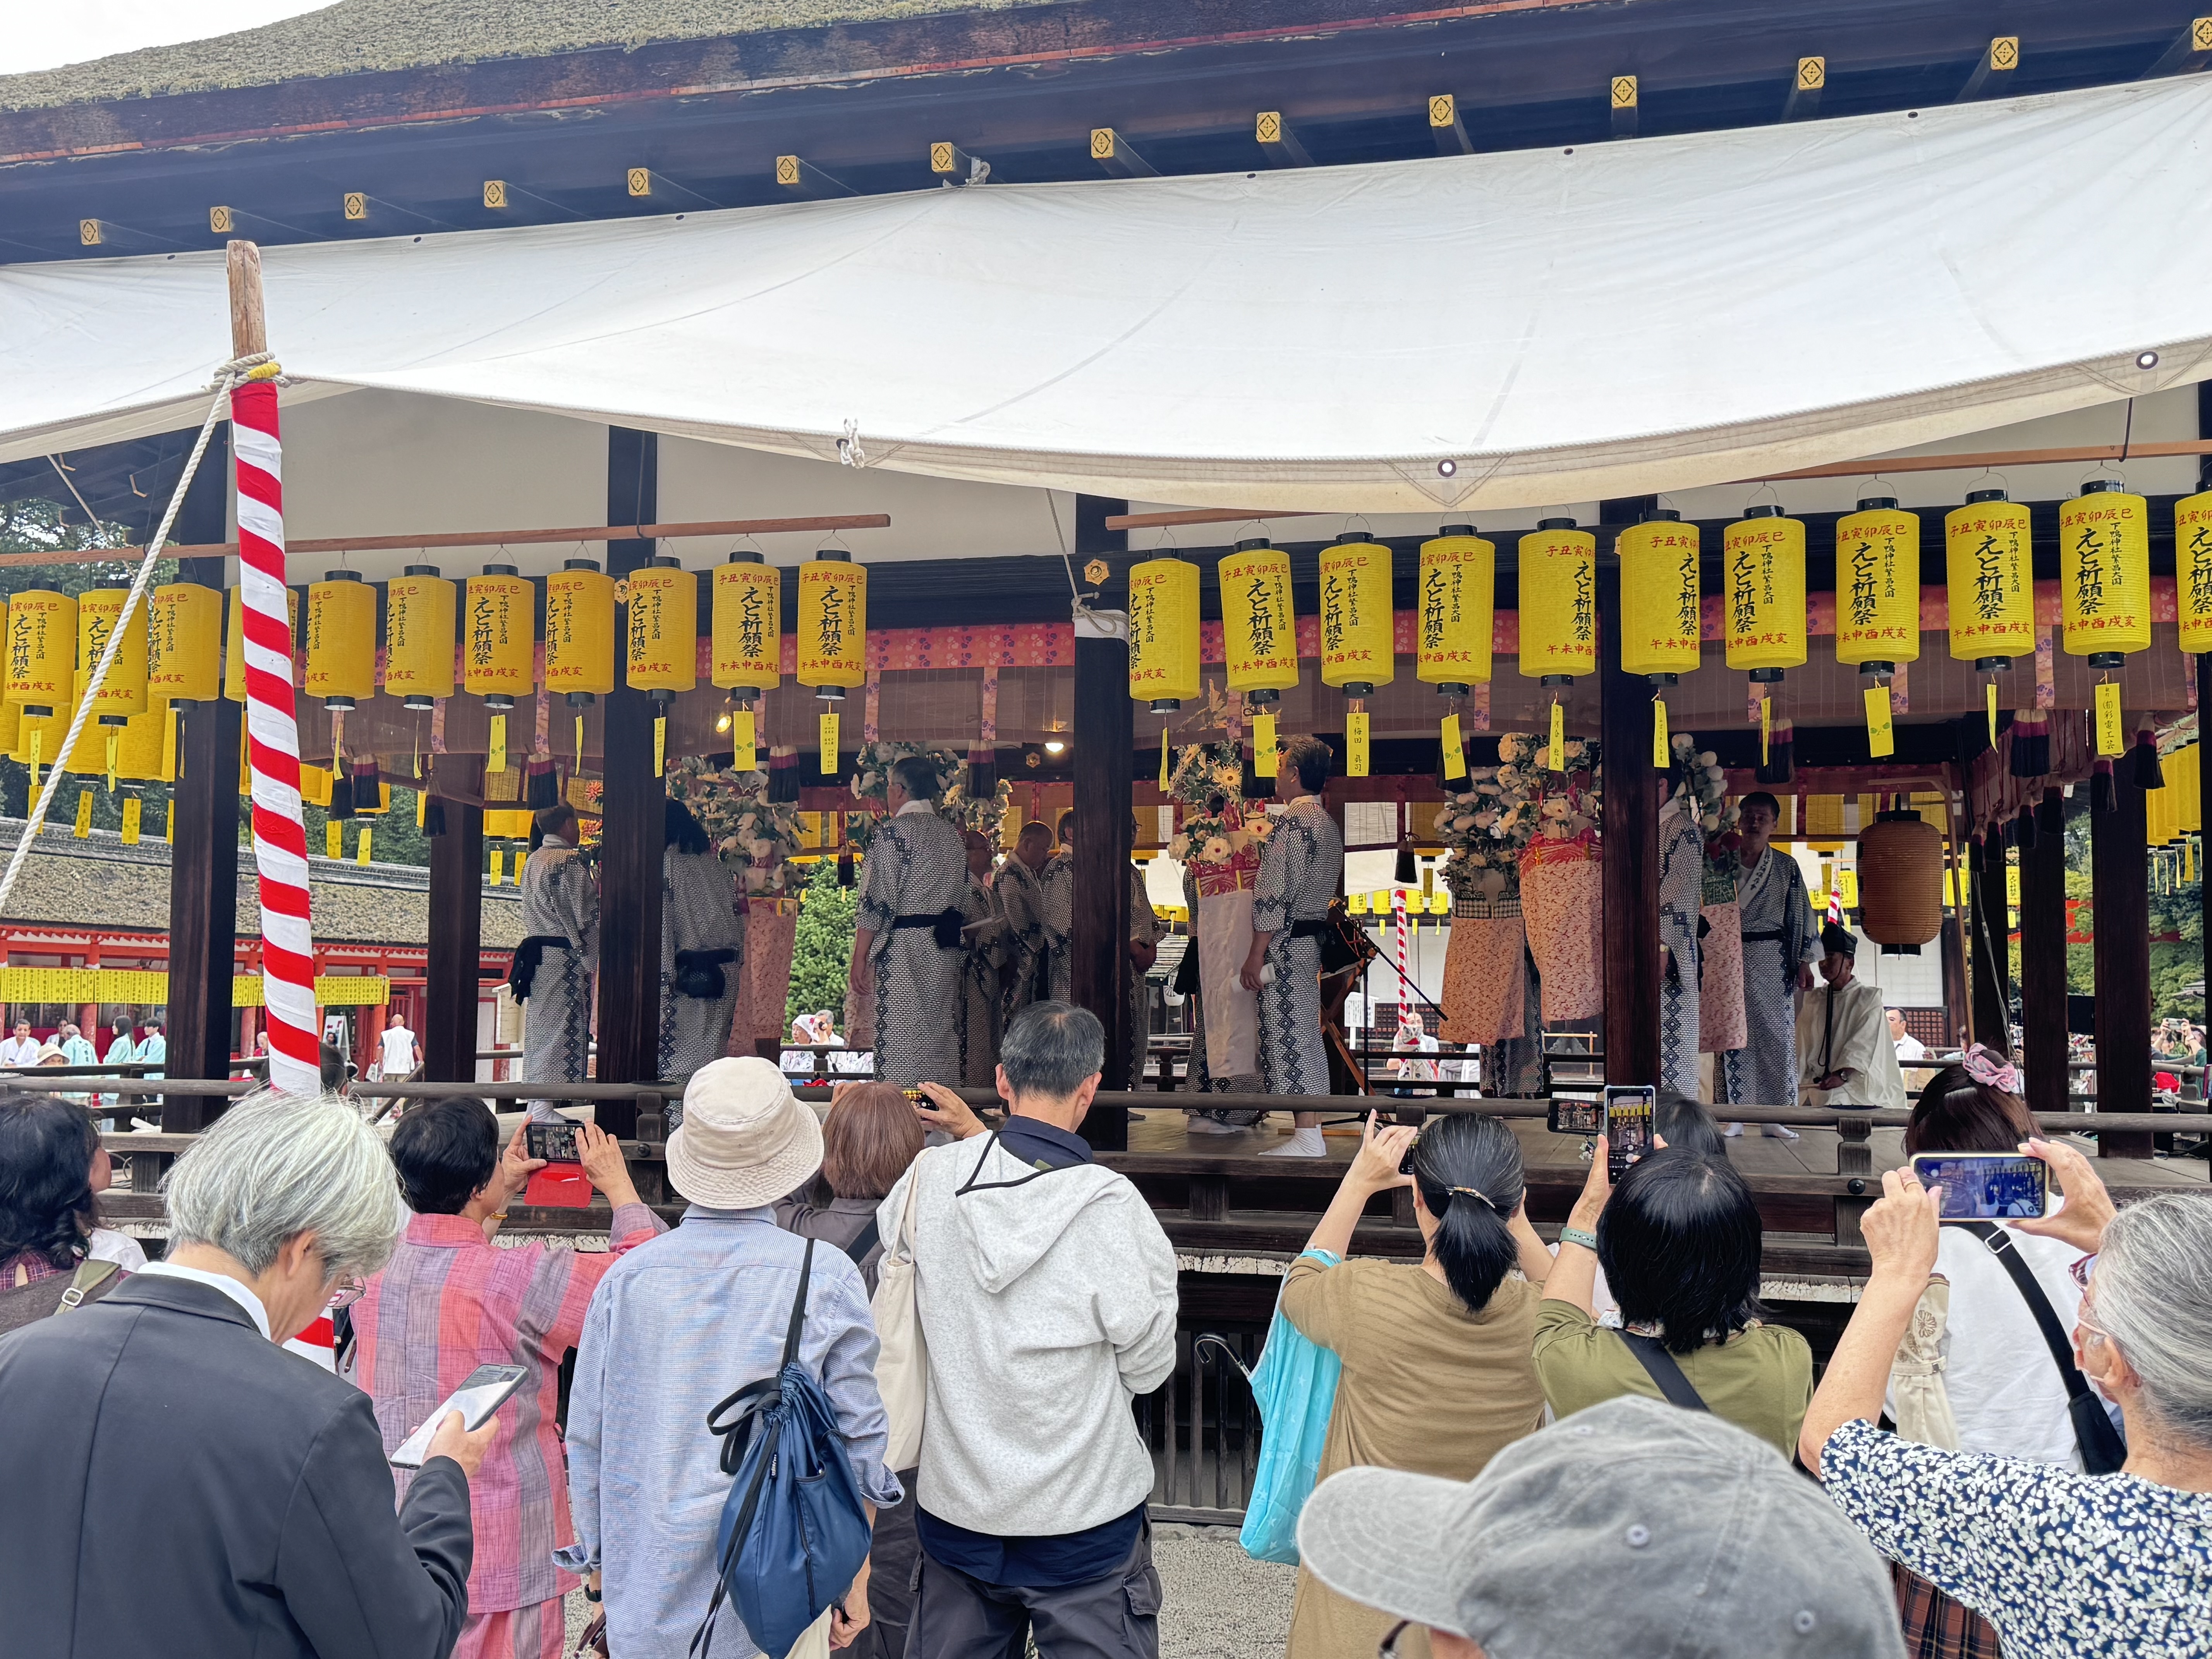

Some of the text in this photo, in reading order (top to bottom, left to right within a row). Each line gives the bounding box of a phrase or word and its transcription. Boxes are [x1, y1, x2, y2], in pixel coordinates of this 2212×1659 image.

[1423, 568, 1447, 649] えと祈願祭
[1571, 560, 1592, 641] えと祈願祭
[1676, 553, 1697, 635] えと祈願祭
[1732, 551, 1758, 634] えと祈願祭
[1849, 542, 1879, 625] えと祈願祭
[1973, 535, 2007, 620] えと祈願祭
[2074, 527, 2106, 616] えと祈願祭
[11, 614, 32, 679] えと祈願祭
[472, 597, 494, 665] えと祈願祭
[630, 593, 647, 661] えと祈願祭
[738, 586, 763, 658] えと祈願祭
[817, 586, 843, 656] えと祈願祭
[1247, 578, 1276, 656] えと祈願祭
[1324, 575, 1345, 651] えと祈願祭
